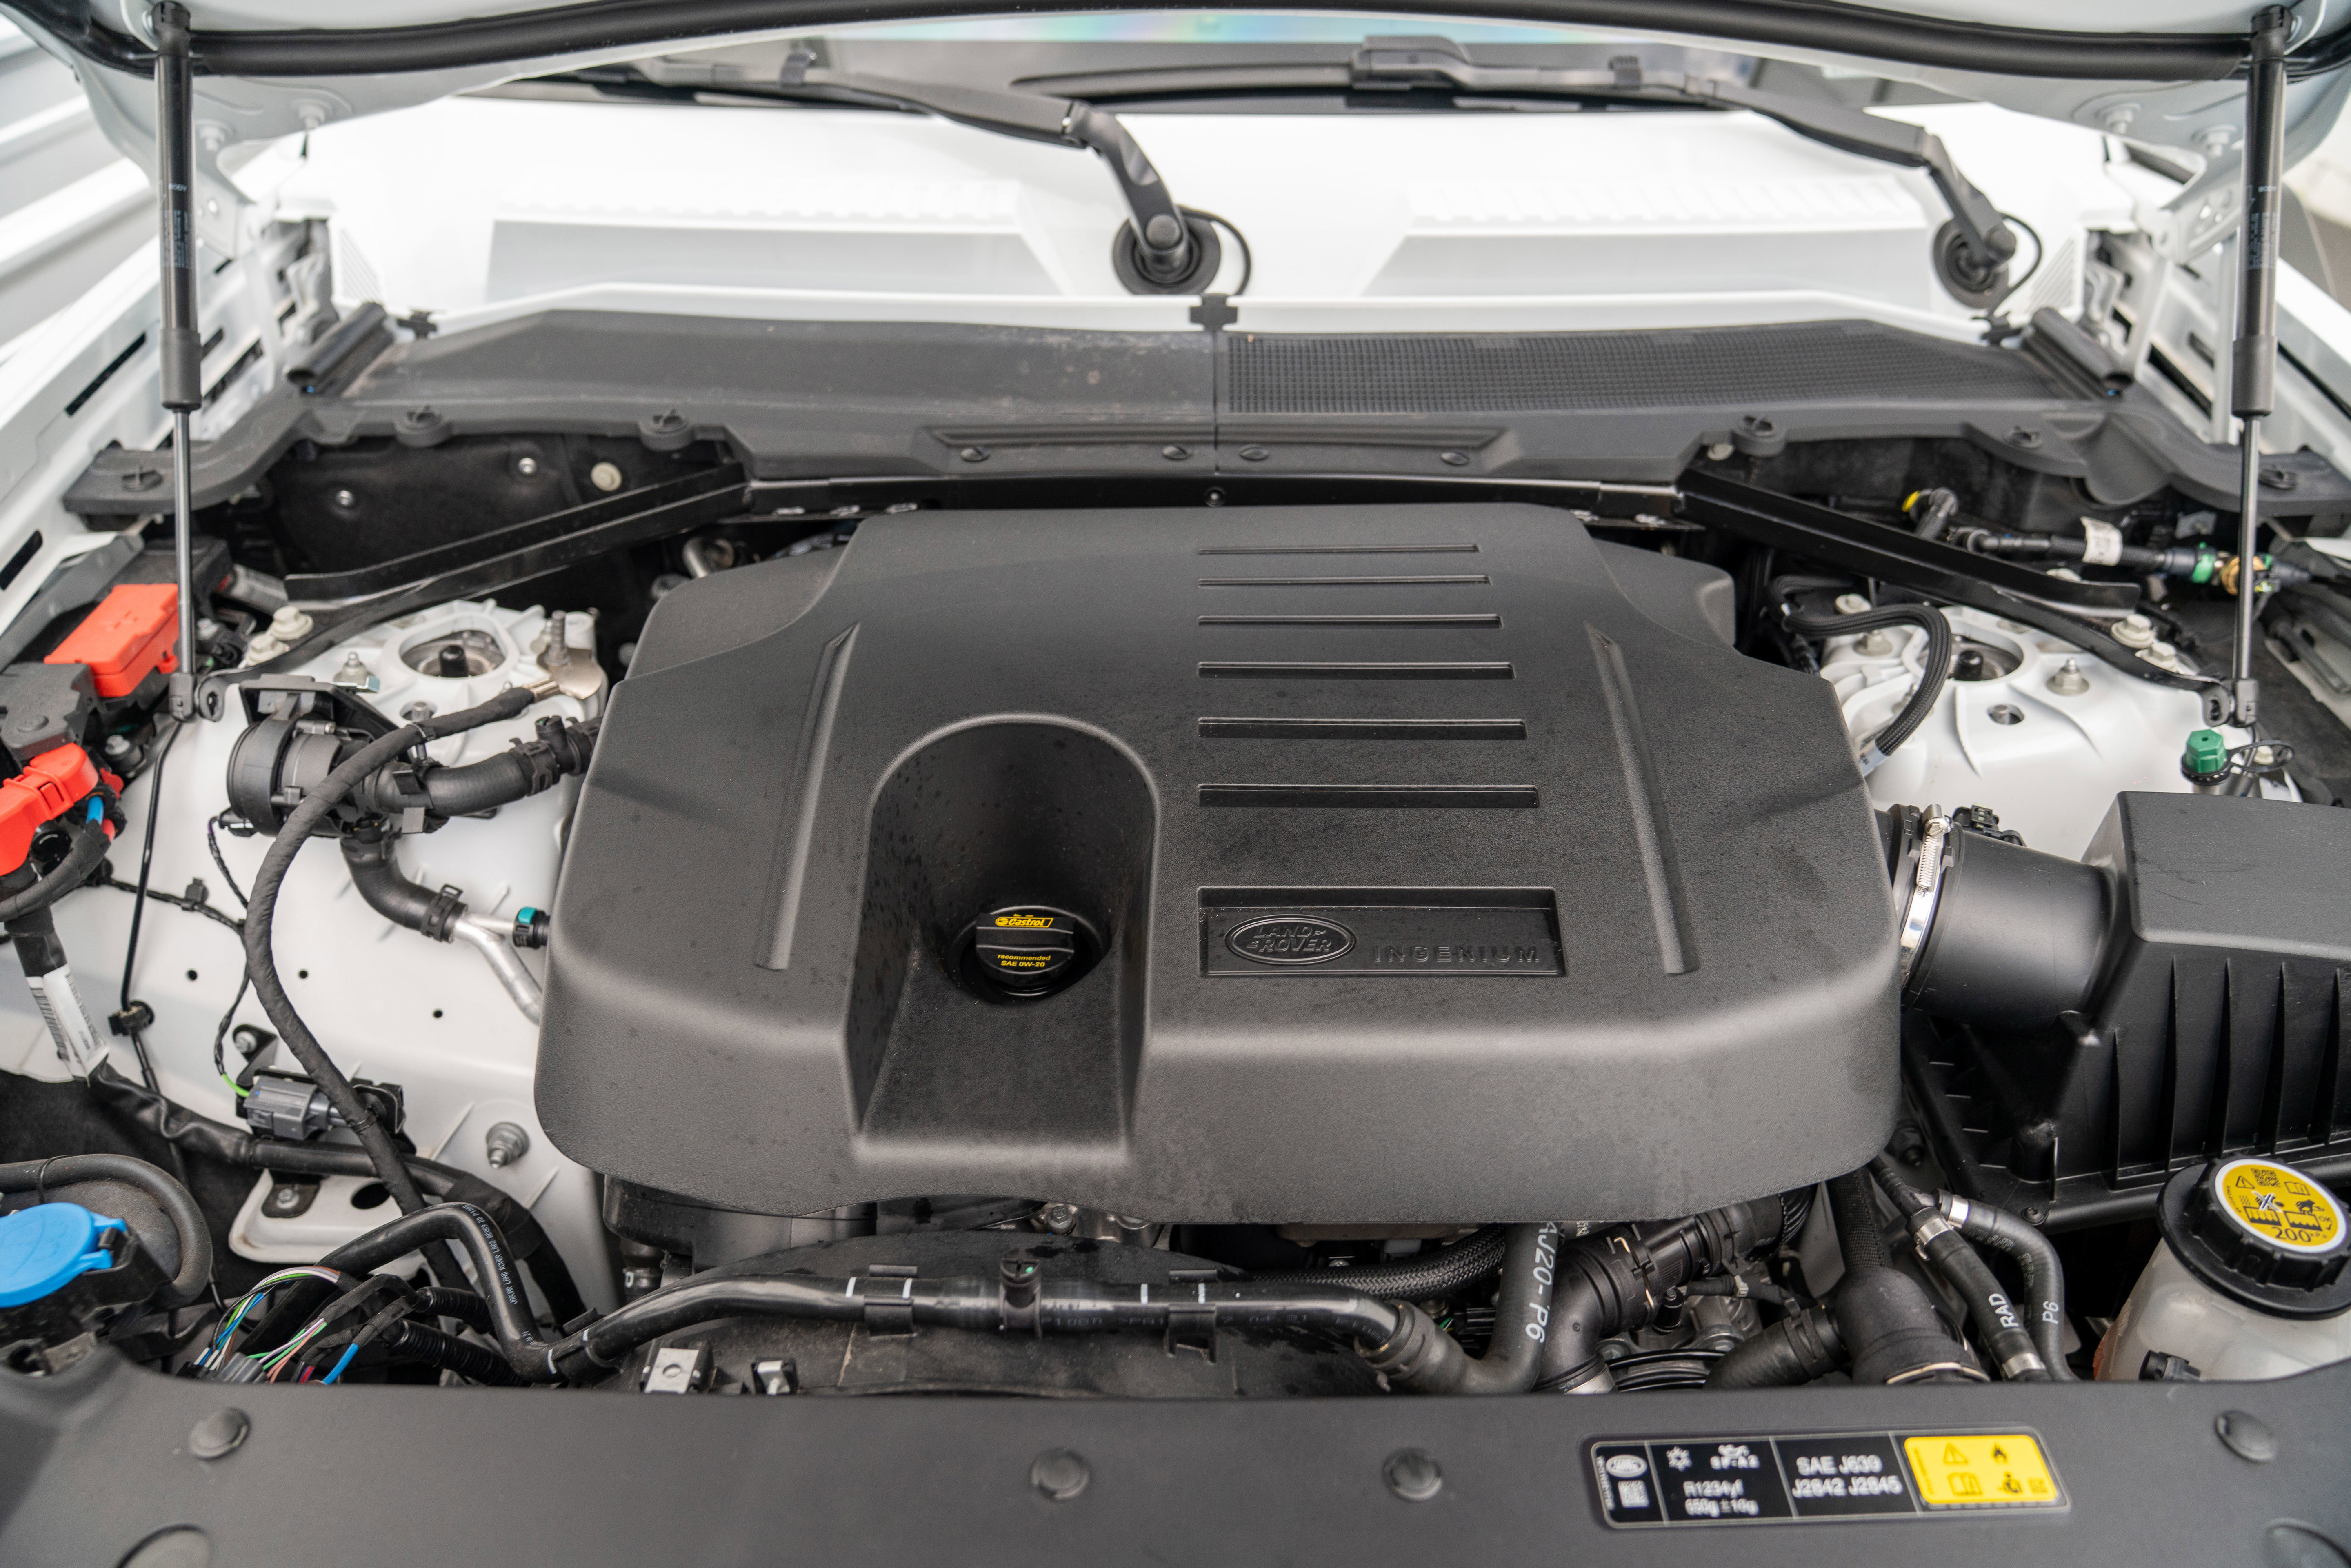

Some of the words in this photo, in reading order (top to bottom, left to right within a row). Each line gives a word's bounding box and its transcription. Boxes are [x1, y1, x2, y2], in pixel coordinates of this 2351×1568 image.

[1008, 918, 1045, 926] Castrol
[1253, 926, 1313, 938] LAND
[1259, 938, 1332, 952] ROVER
[1373, 945, 1539, 964] INGENIUM
[2271, 1227, 2311, 1242] 200
[494, 1254, 507, 1270] ROVER
[500, 1271, 512, 1285] LAND
[1988, 1293, 2019, 1328] RAD
[2042, 1301, 2059, 1324] P6
[1796, 1456, 1837, 1476] SAE
